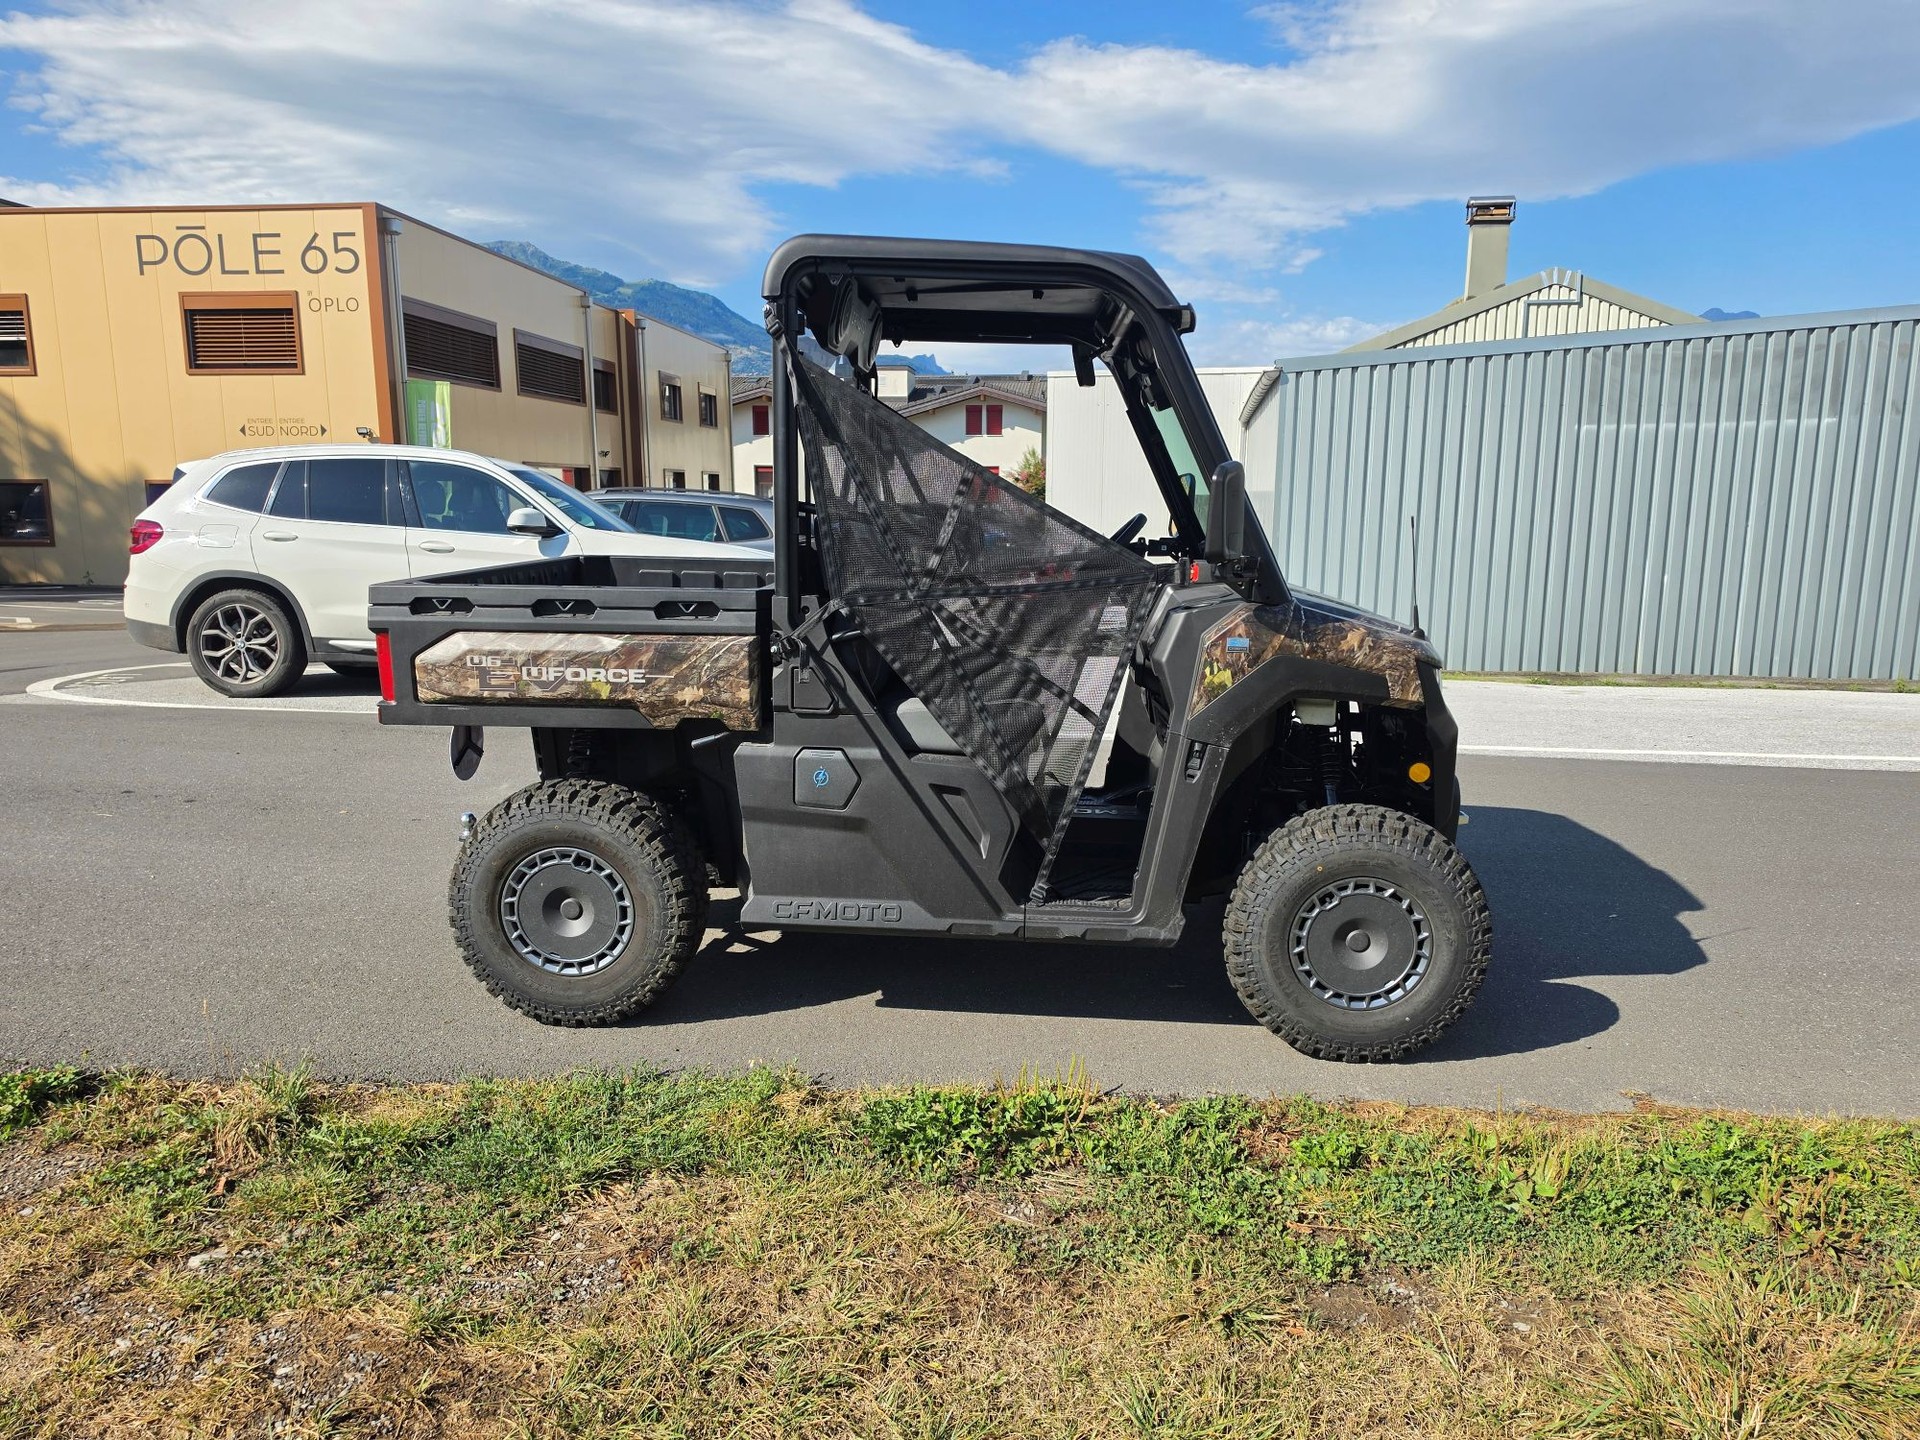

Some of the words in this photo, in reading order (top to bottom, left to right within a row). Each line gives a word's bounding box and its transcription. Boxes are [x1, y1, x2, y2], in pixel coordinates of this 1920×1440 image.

[301, 231, 360, 275] 65
[308, 297, 359, 312] OPLO
[248, 425, 275, 437] SUD
[280, 425, 319, 437] NORD
[772, 901, 902, 922] CFMOTO
